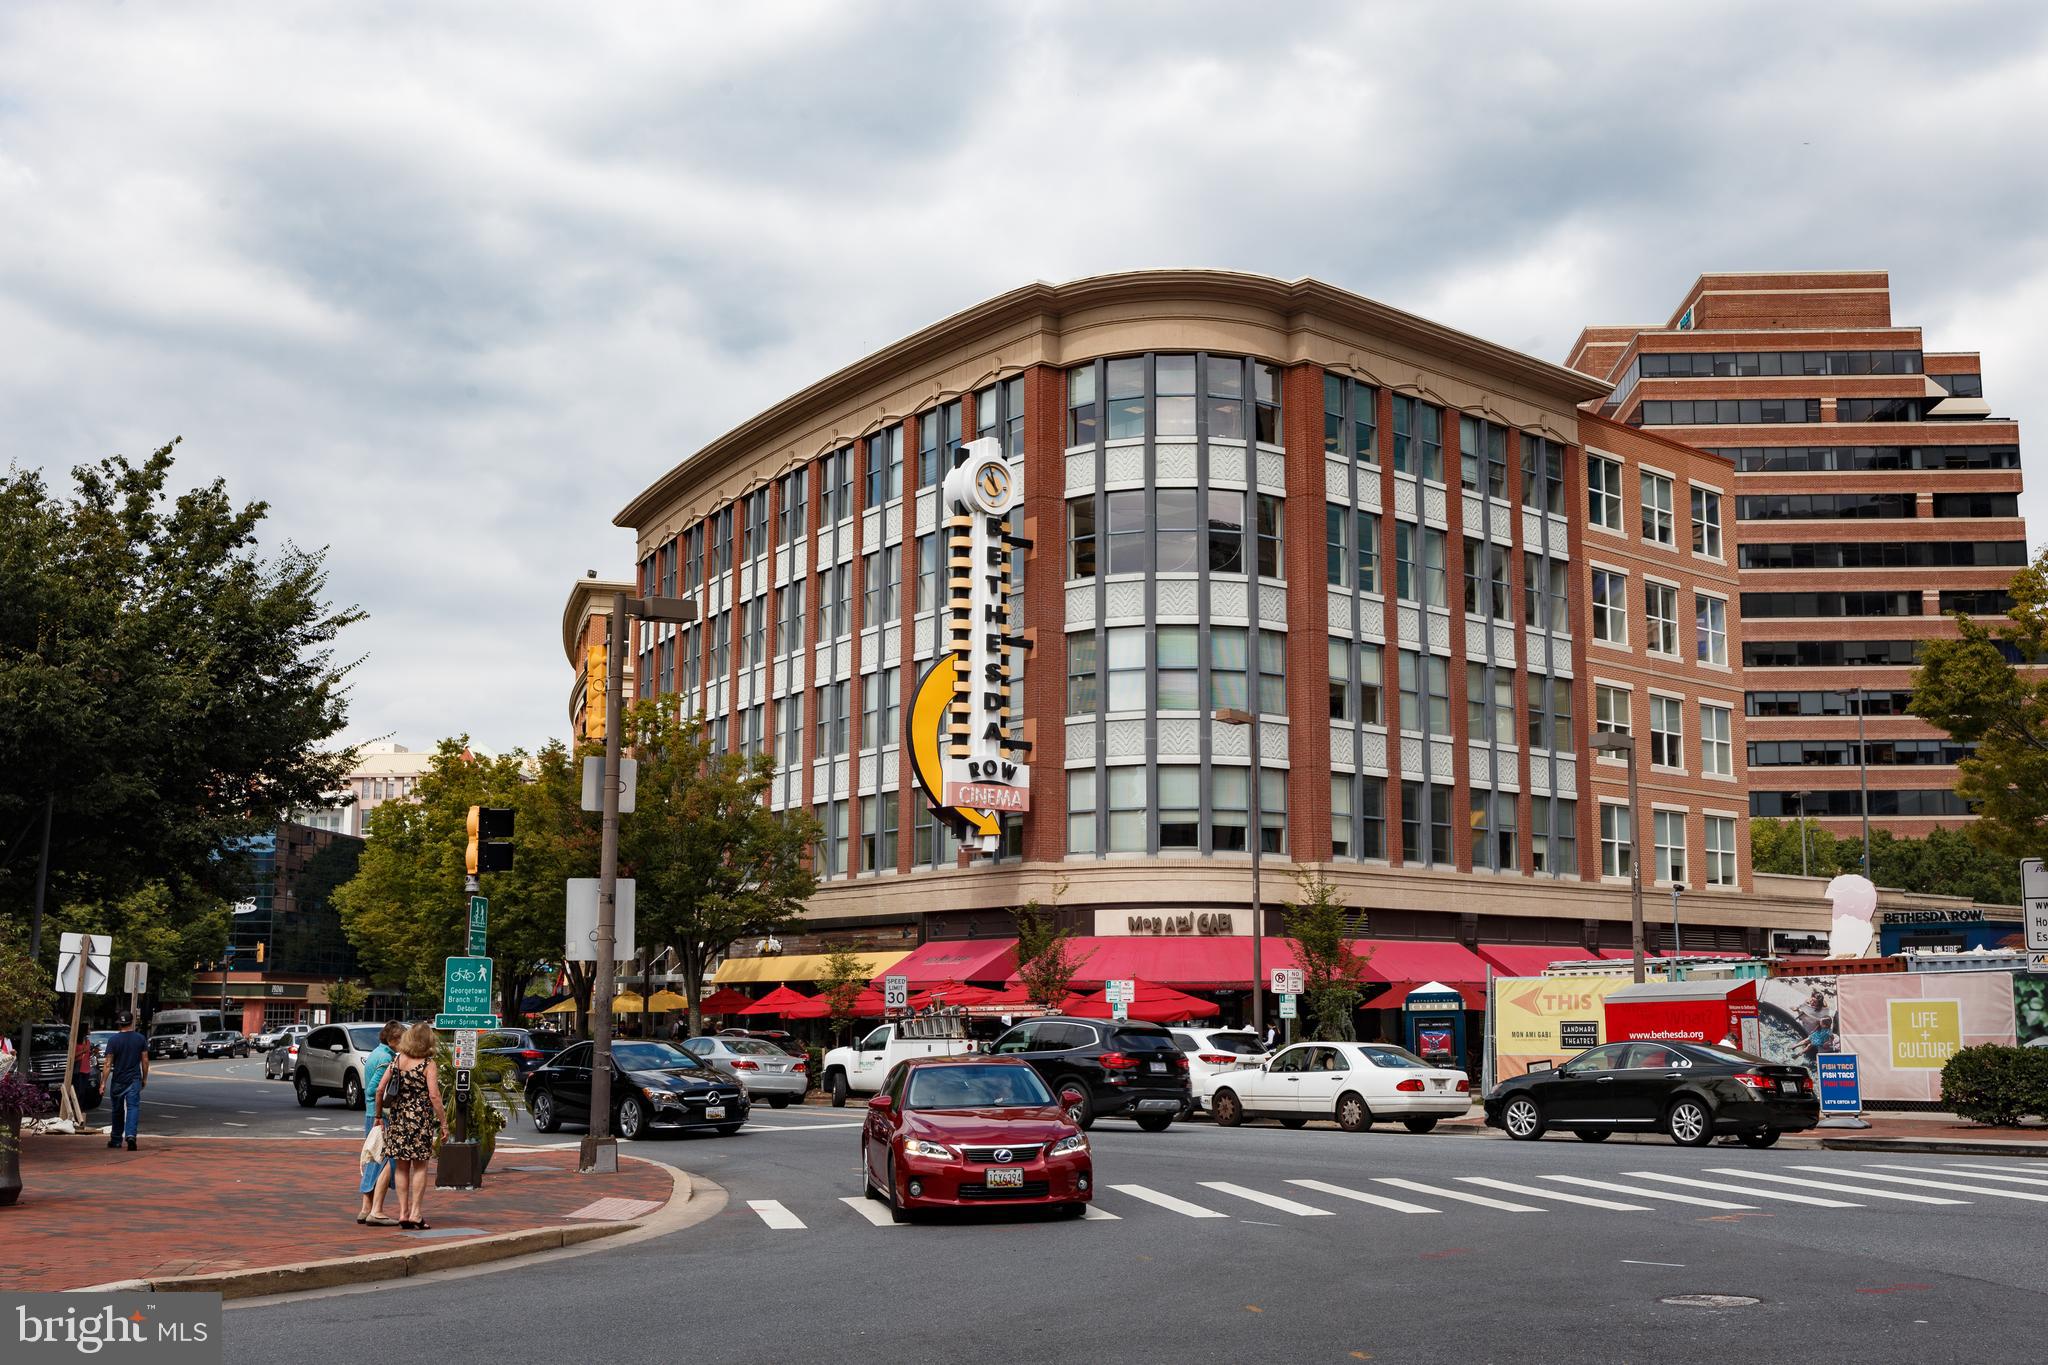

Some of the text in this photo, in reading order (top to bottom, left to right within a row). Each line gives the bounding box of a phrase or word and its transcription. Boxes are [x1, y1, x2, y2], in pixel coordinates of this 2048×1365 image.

[983, 517, 1002, 740] BETHESDA
[968, 760, 1017, 780] ROW
[960, 786, 1021, 808] CINEMA
[1197, 913, 1233, 934] GABI
[1884, 909, 1984, 923] BETHESDA ROW
[450, 987, 486, 995] Georgetown
[888, 992, 905, 1004] 30
[1543, 994, 1592, 1010] THIS
[1912, 1012, 1938, 1028] LIFE
[1629, 1029, 1703, 1040] www.bethesda.org
[989, 1172, 1021, 1182] 1CY6394
